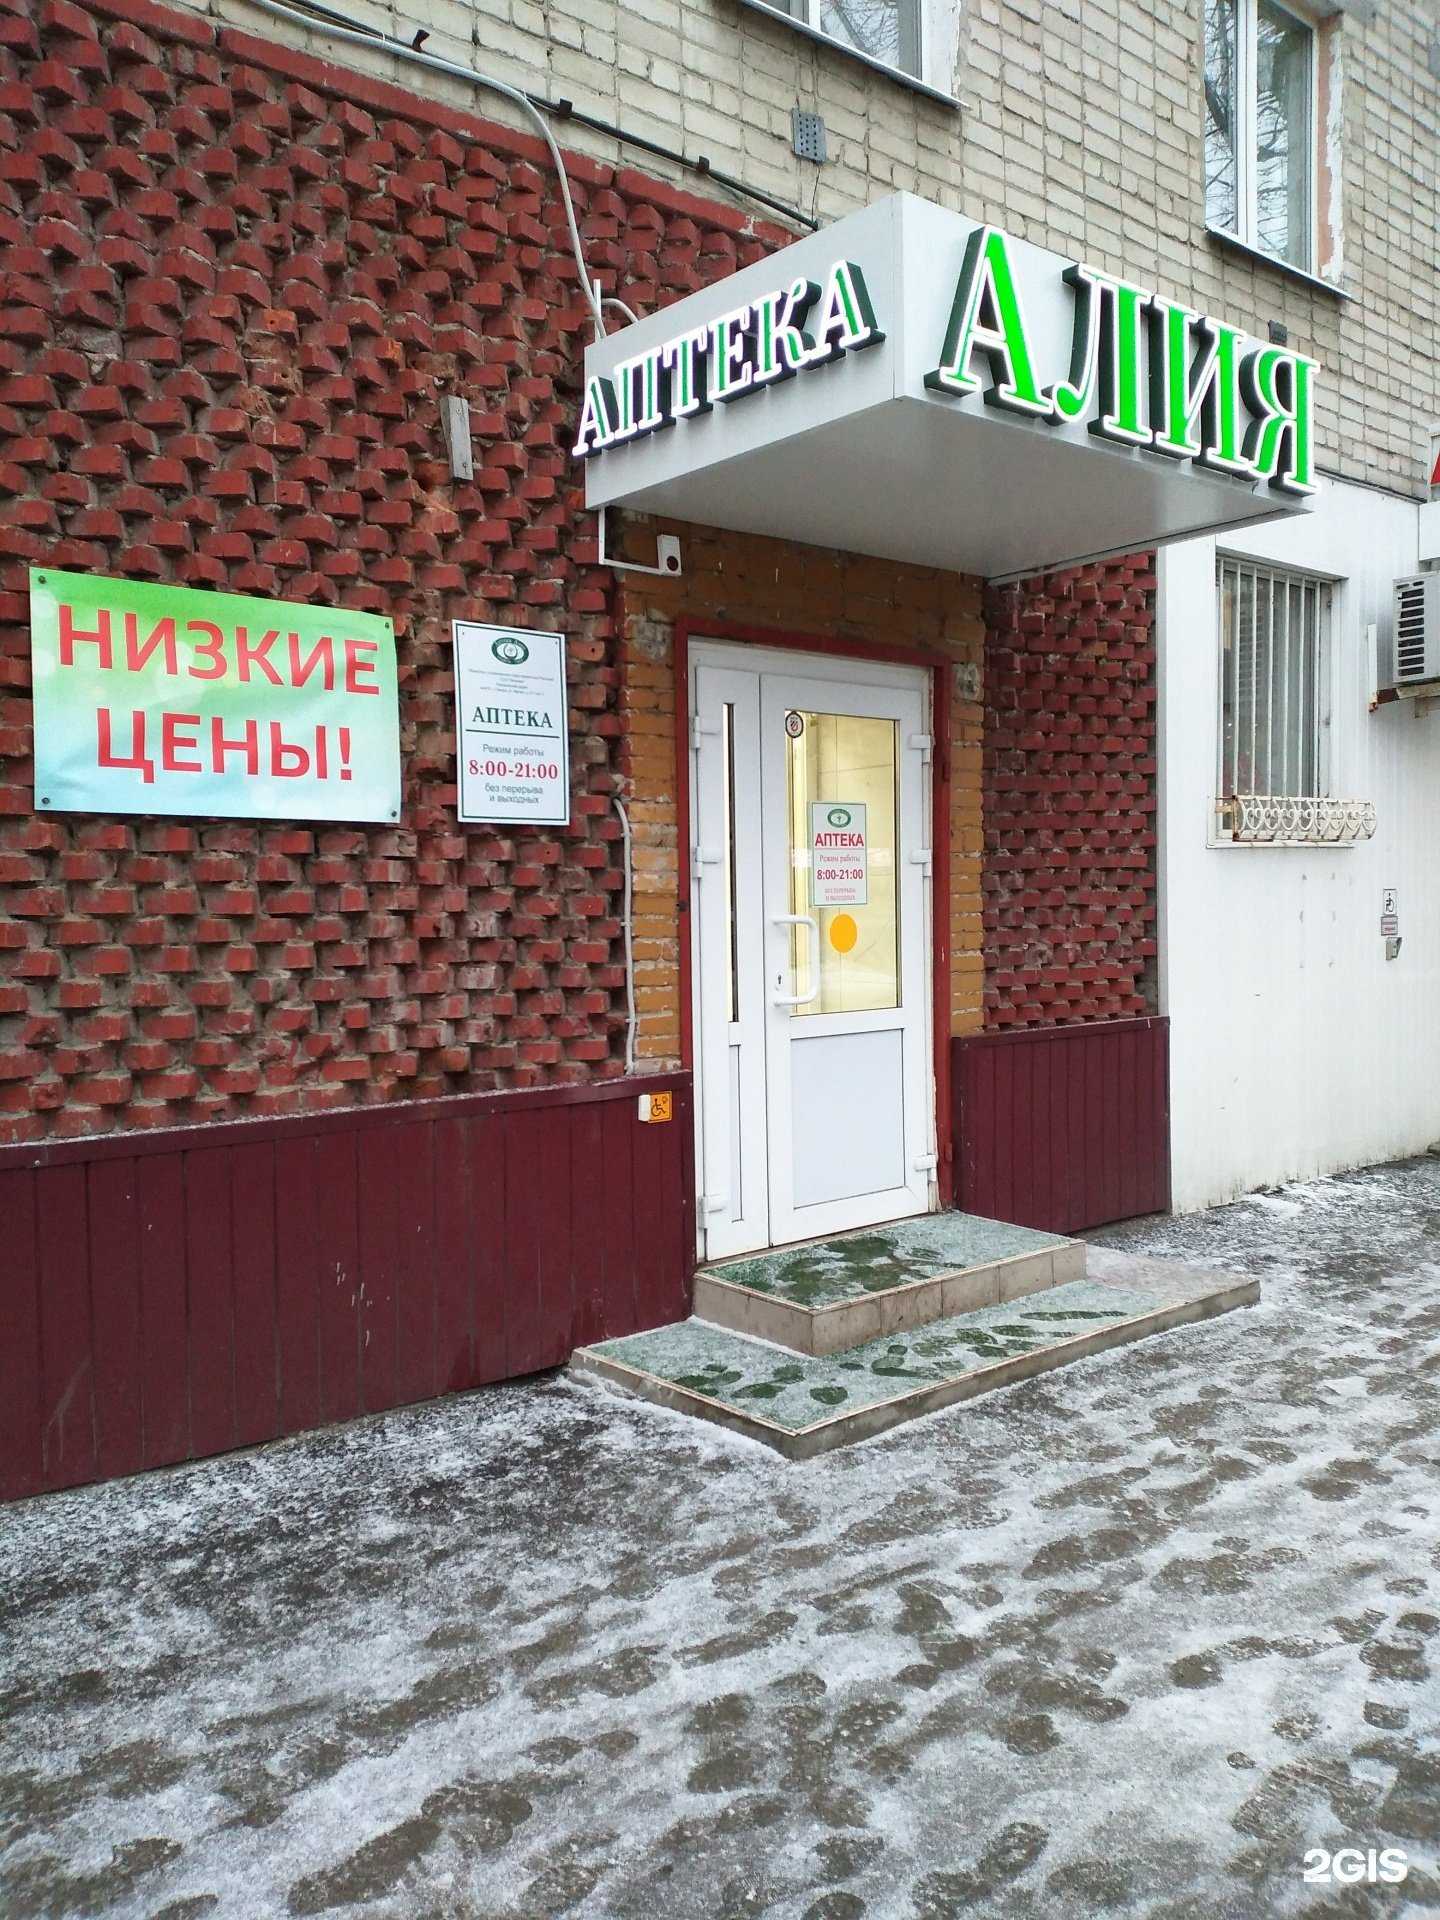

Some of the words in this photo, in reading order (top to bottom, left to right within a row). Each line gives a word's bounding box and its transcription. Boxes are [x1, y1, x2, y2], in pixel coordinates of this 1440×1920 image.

[571, 259, 884, 457] АПТЕКА
[925, 225, 1320, 494] АЛИЯ
[58, 604, 380, 695] НИЗКИЕ
[472, 706, 553, 729] АПТЕКА
[97, 707, 352, 784] ЦЕНЫ!
[482, 743, 511, 754] Режим
[513, 746, 545, 757] работы
[469, 759, 558, 780] 8:00-21:00
[815, 832, 864, 847] АПТЕКА
[816, 868, 864, 881] 8:00-21:00
